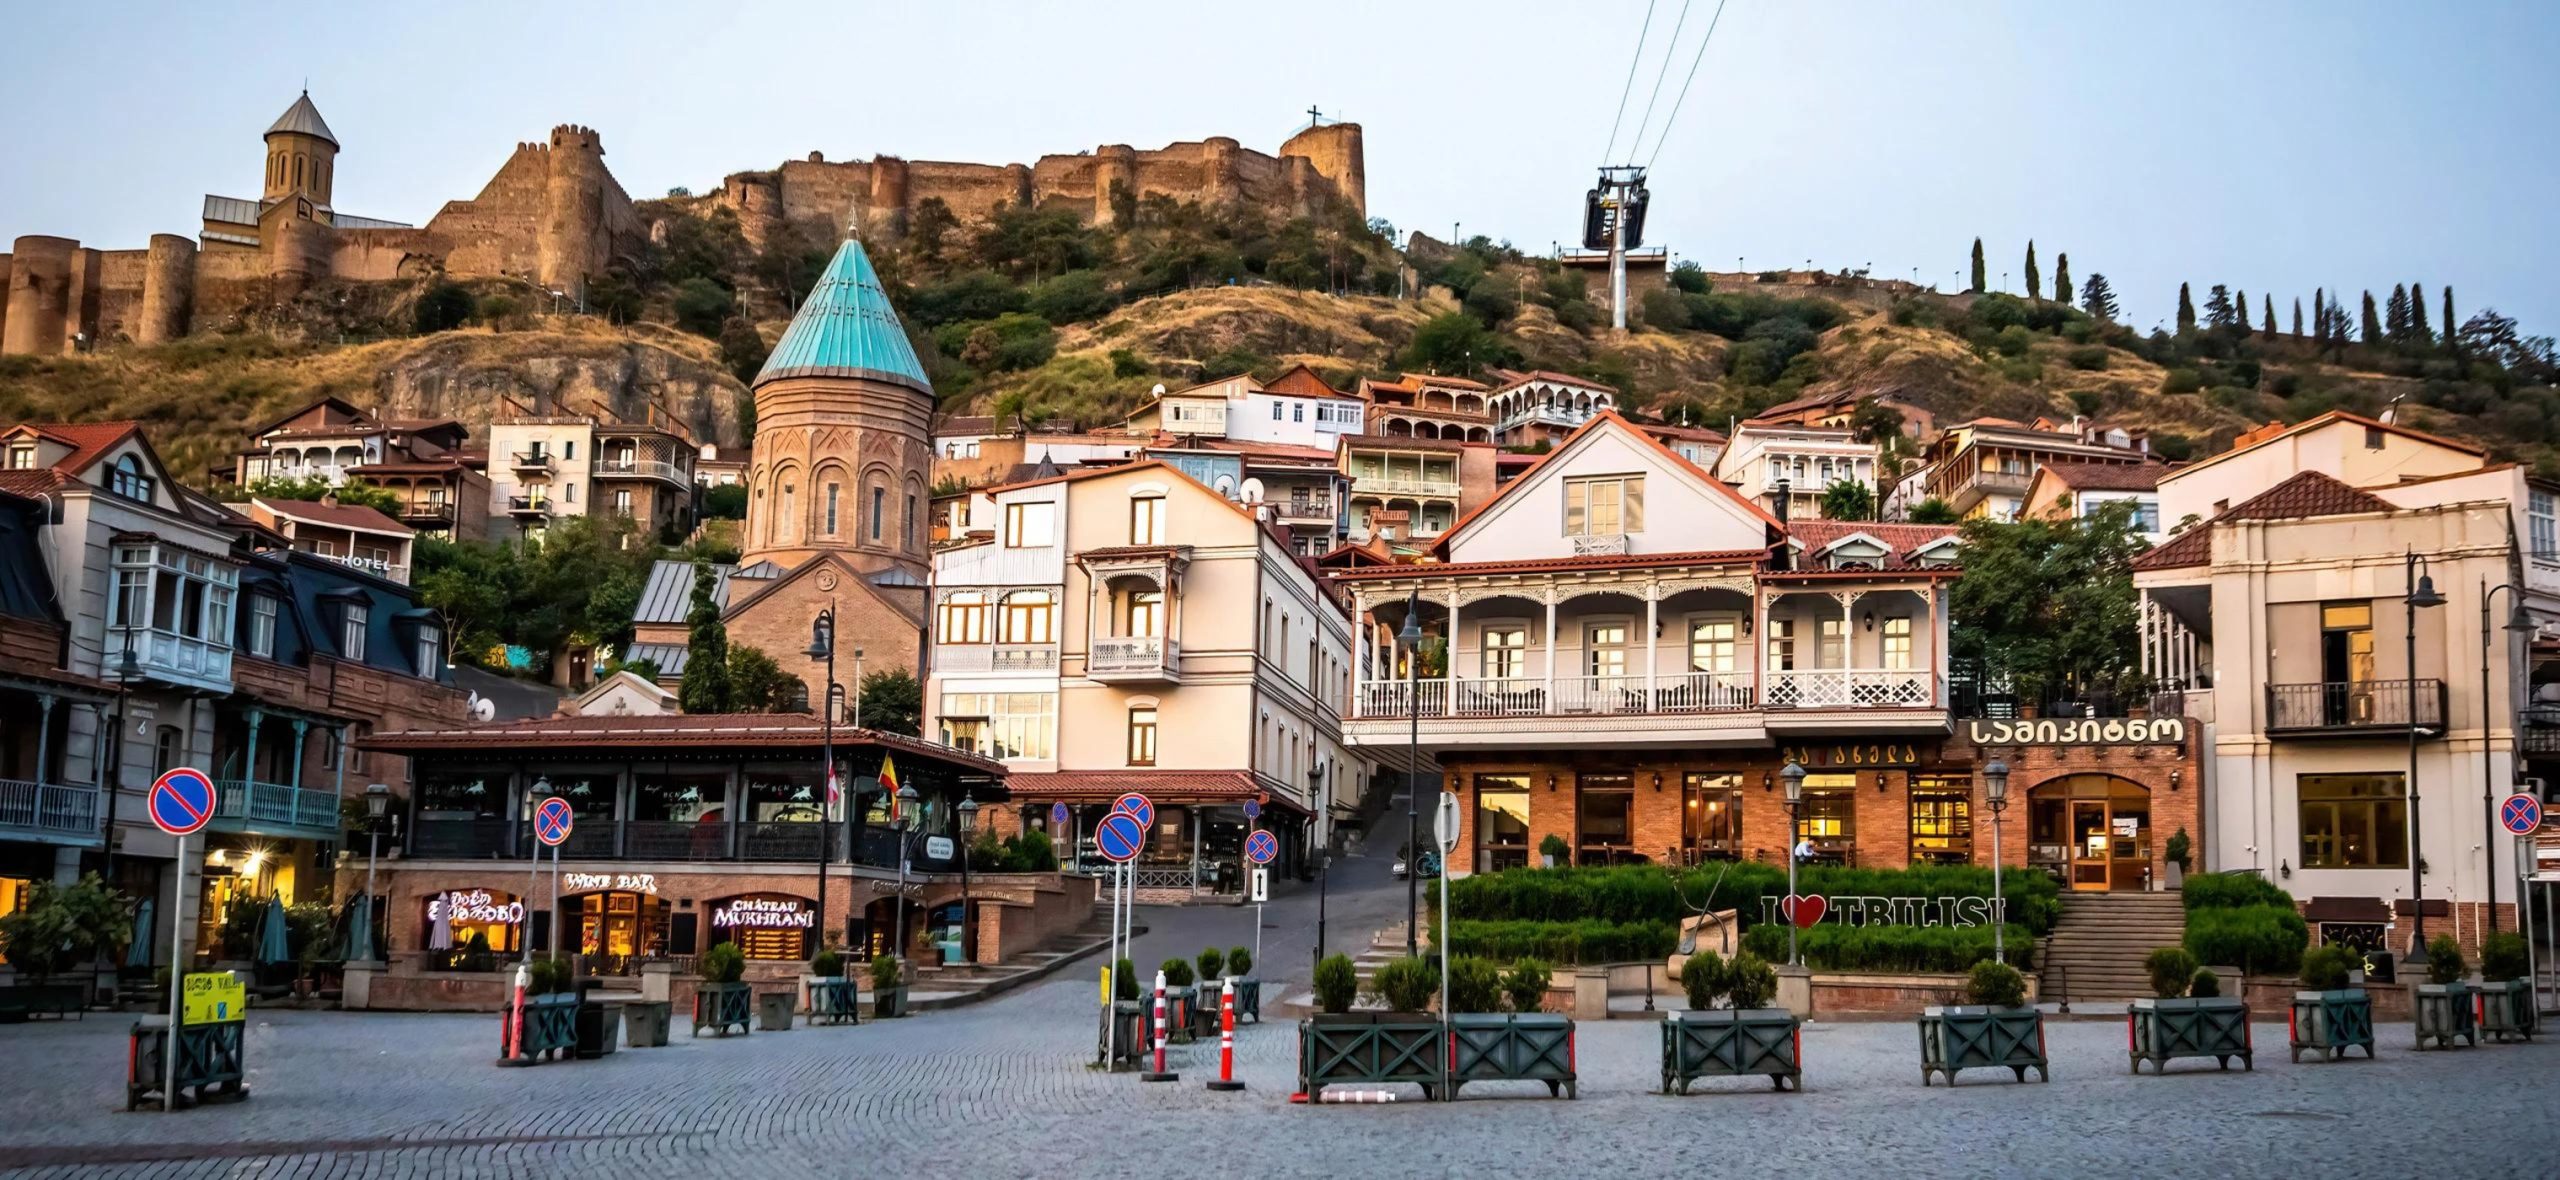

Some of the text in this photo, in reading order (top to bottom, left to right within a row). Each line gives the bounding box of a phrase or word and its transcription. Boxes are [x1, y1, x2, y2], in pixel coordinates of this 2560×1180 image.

[341, 555, 390, 571] HOTEL
[1971, 718, 2184, 744] სამიკიტნო
[1783, 745, 1916, 764] მაახელა
[564, 873, 657, 894] WINE BAR
[713, 907, 815, 928] MUKHRANI
[1829, 895, 2006, 931] TBILISI
